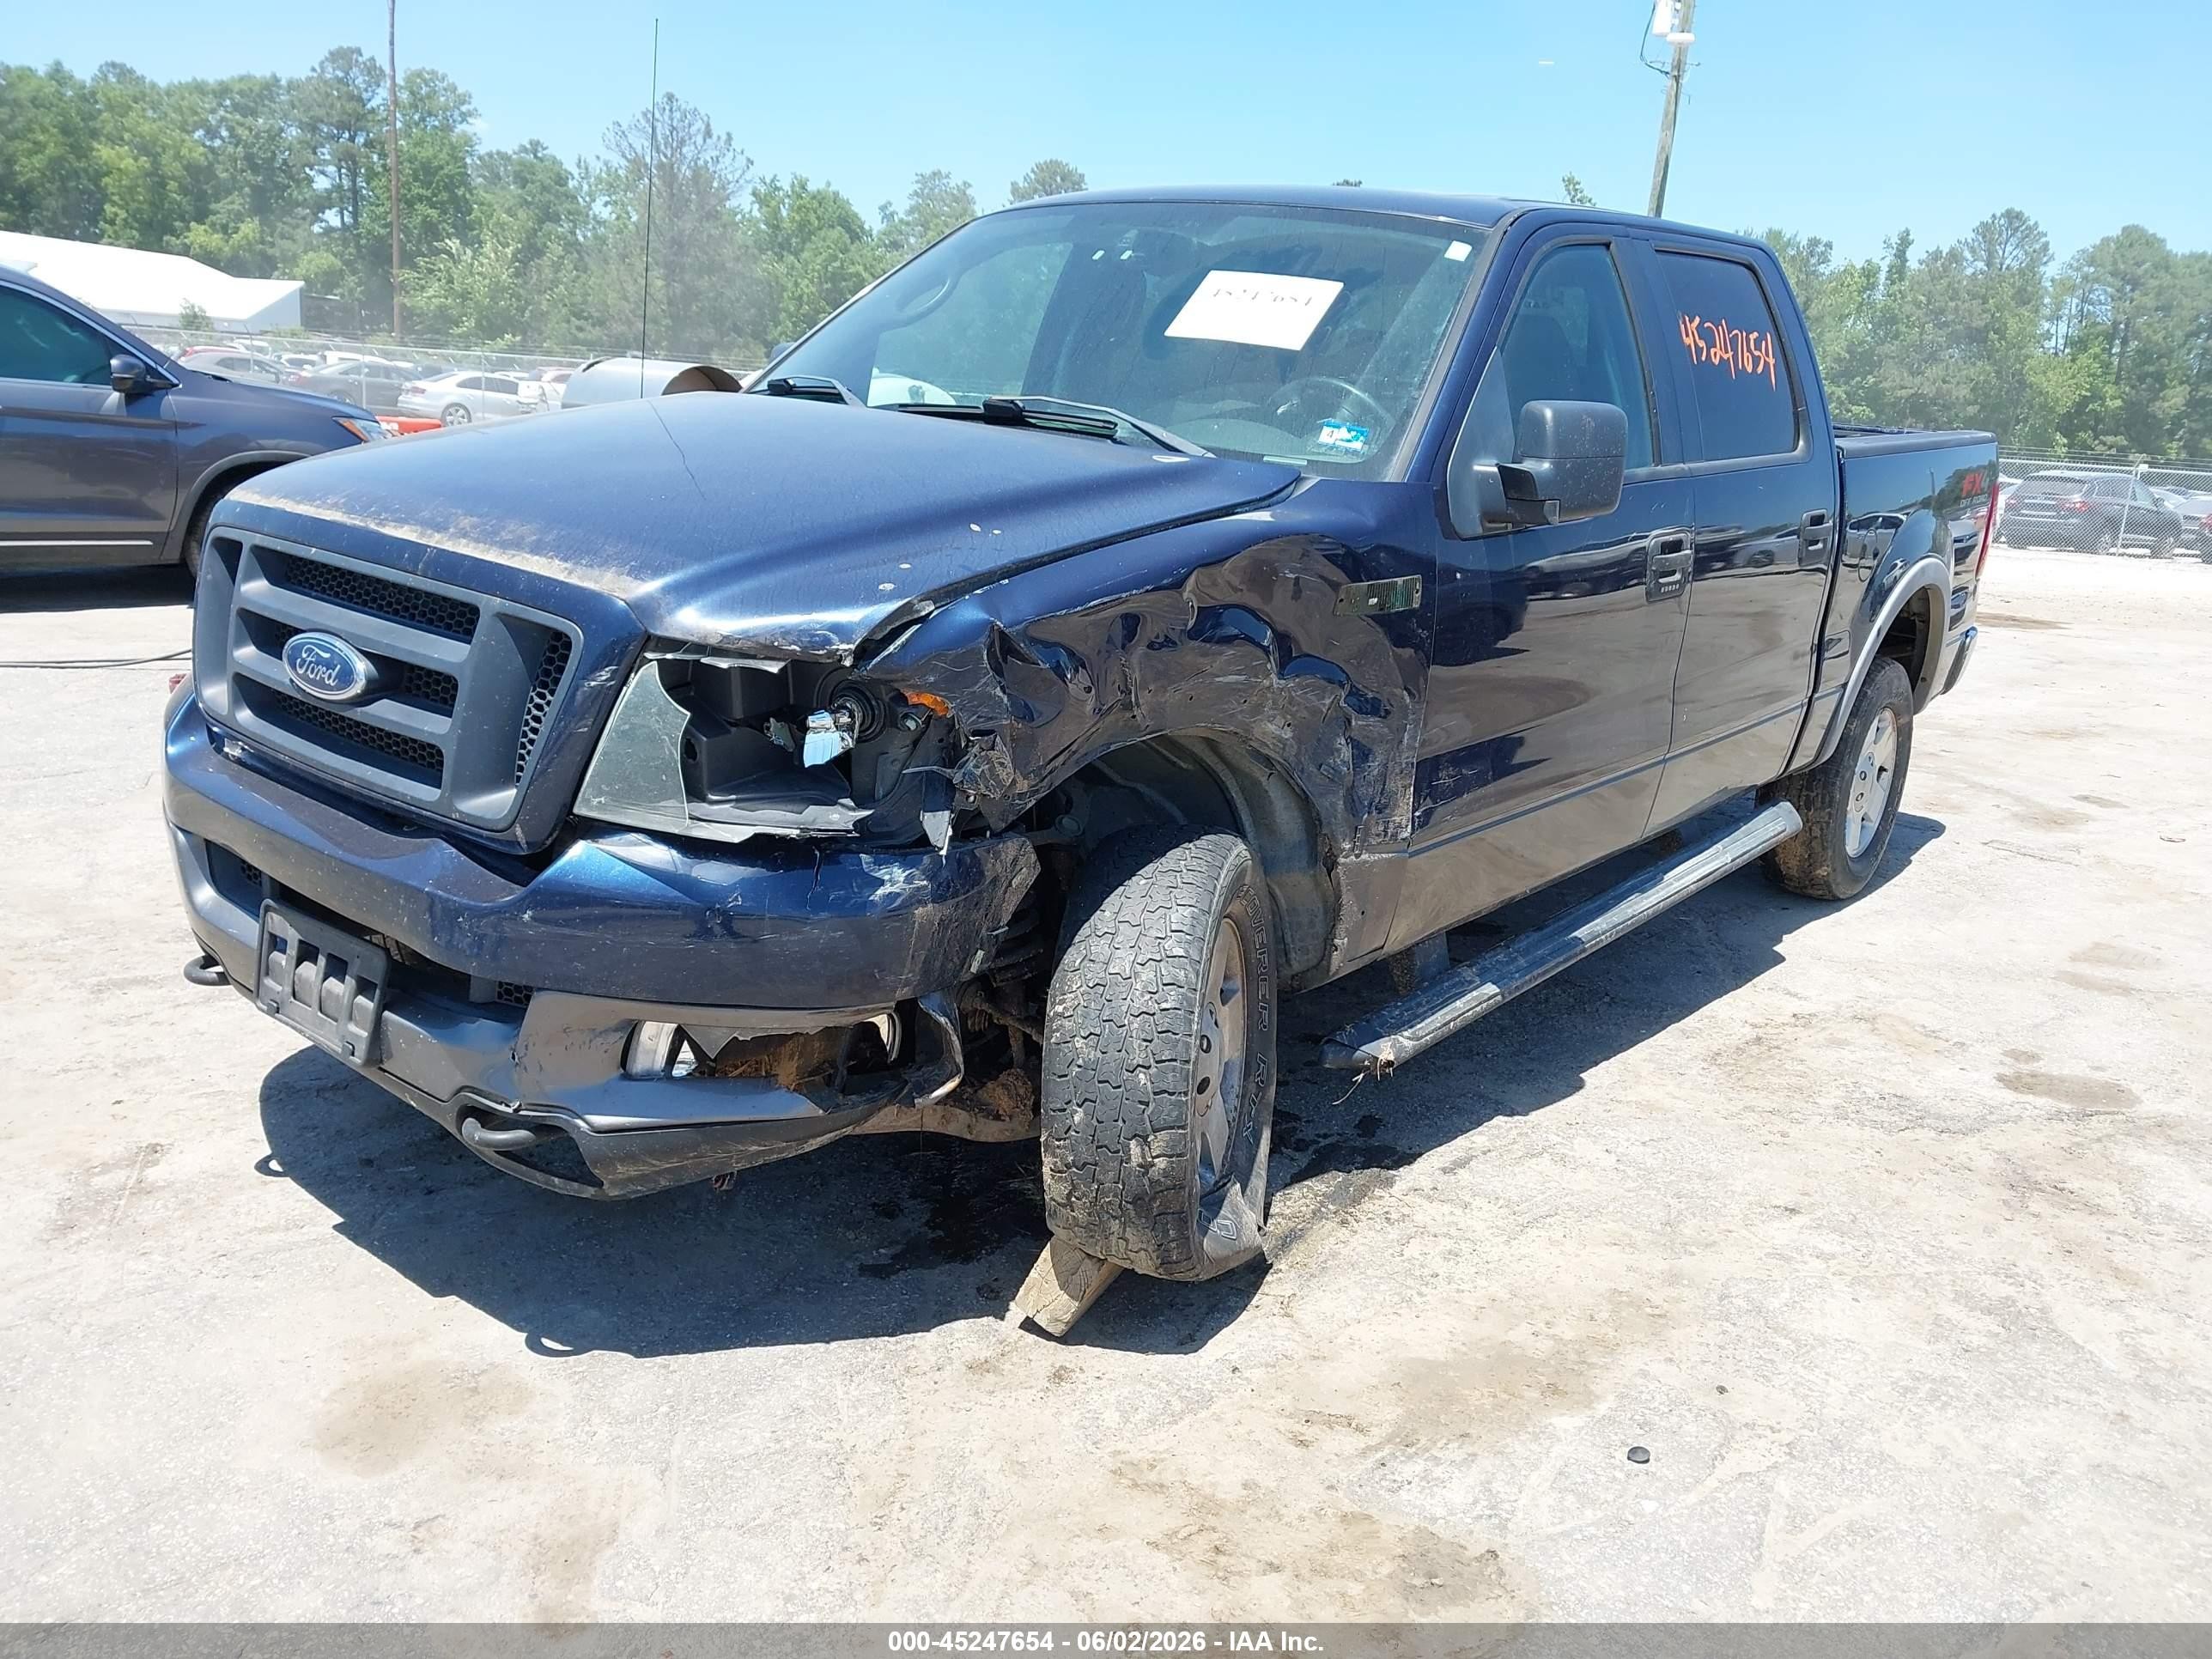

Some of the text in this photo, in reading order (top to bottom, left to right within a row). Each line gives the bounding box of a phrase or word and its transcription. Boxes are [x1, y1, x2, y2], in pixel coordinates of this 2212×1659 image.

[1677, 314, 1776, 392] 45247654
[296, 644, 341, 686] Ford
[1243, 1051, 1268, 1146] RTX
